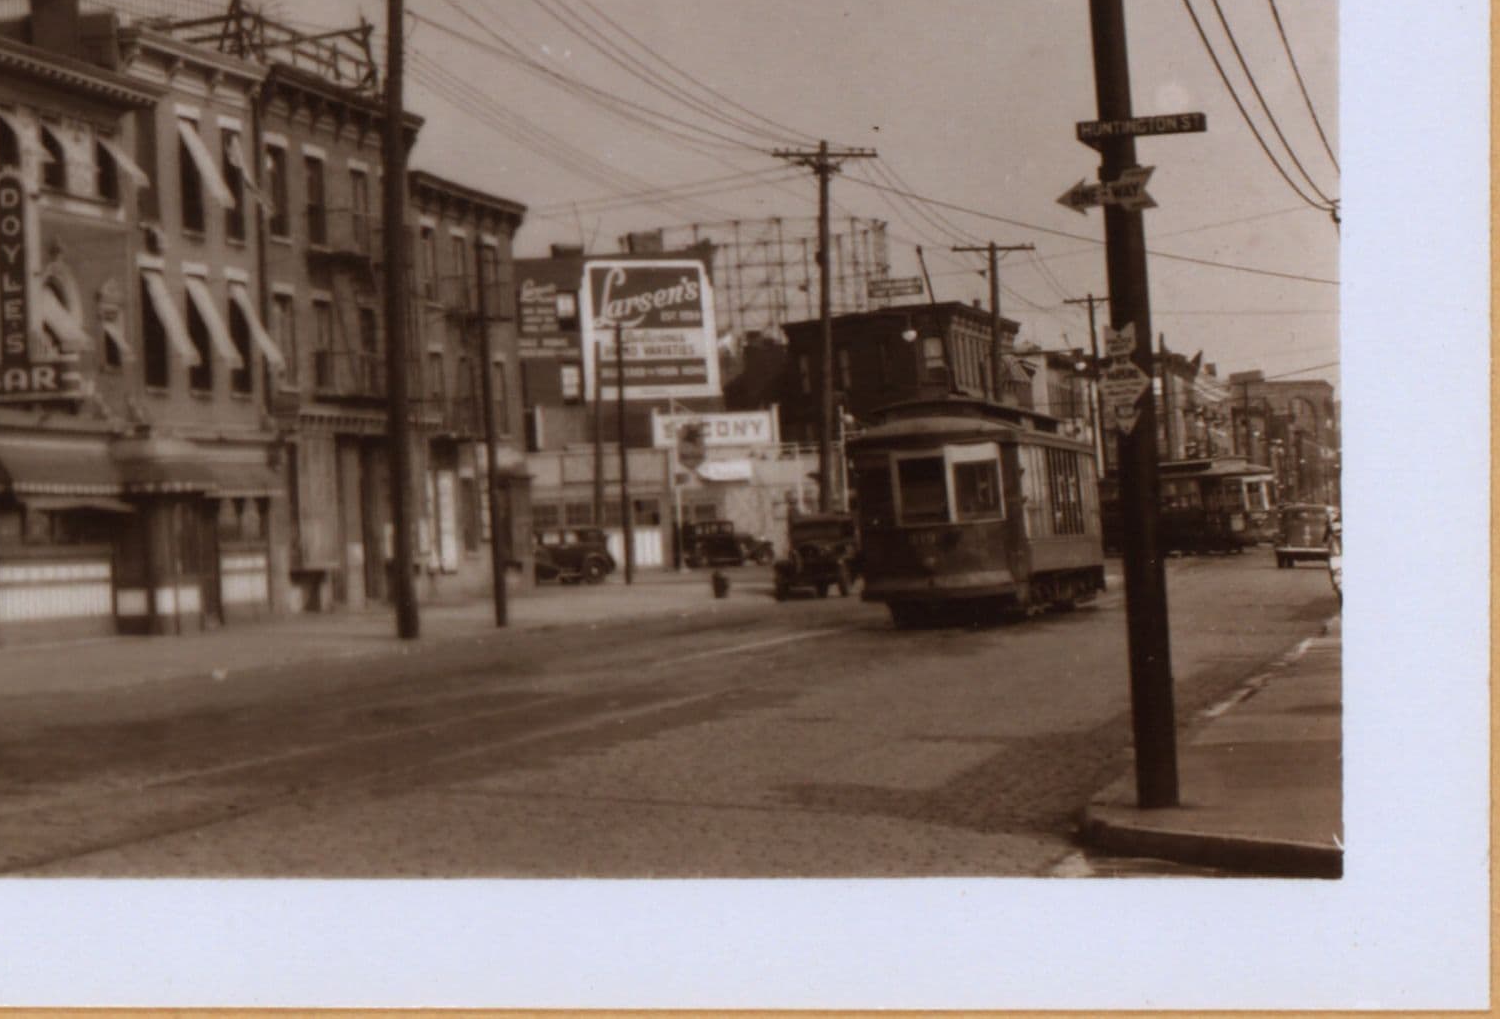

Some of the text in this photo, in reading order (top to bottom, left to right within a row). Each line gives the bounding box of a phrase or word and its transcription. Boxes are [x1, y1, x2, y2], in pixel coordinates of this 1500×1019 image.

[1080, 113, 1201, 134] HUNTINGTON ST
[1111, 182, 1140, 199] WAY
[594, 266, 699, 328] Larsen's
[663, 420, 763, 439] SCONY
